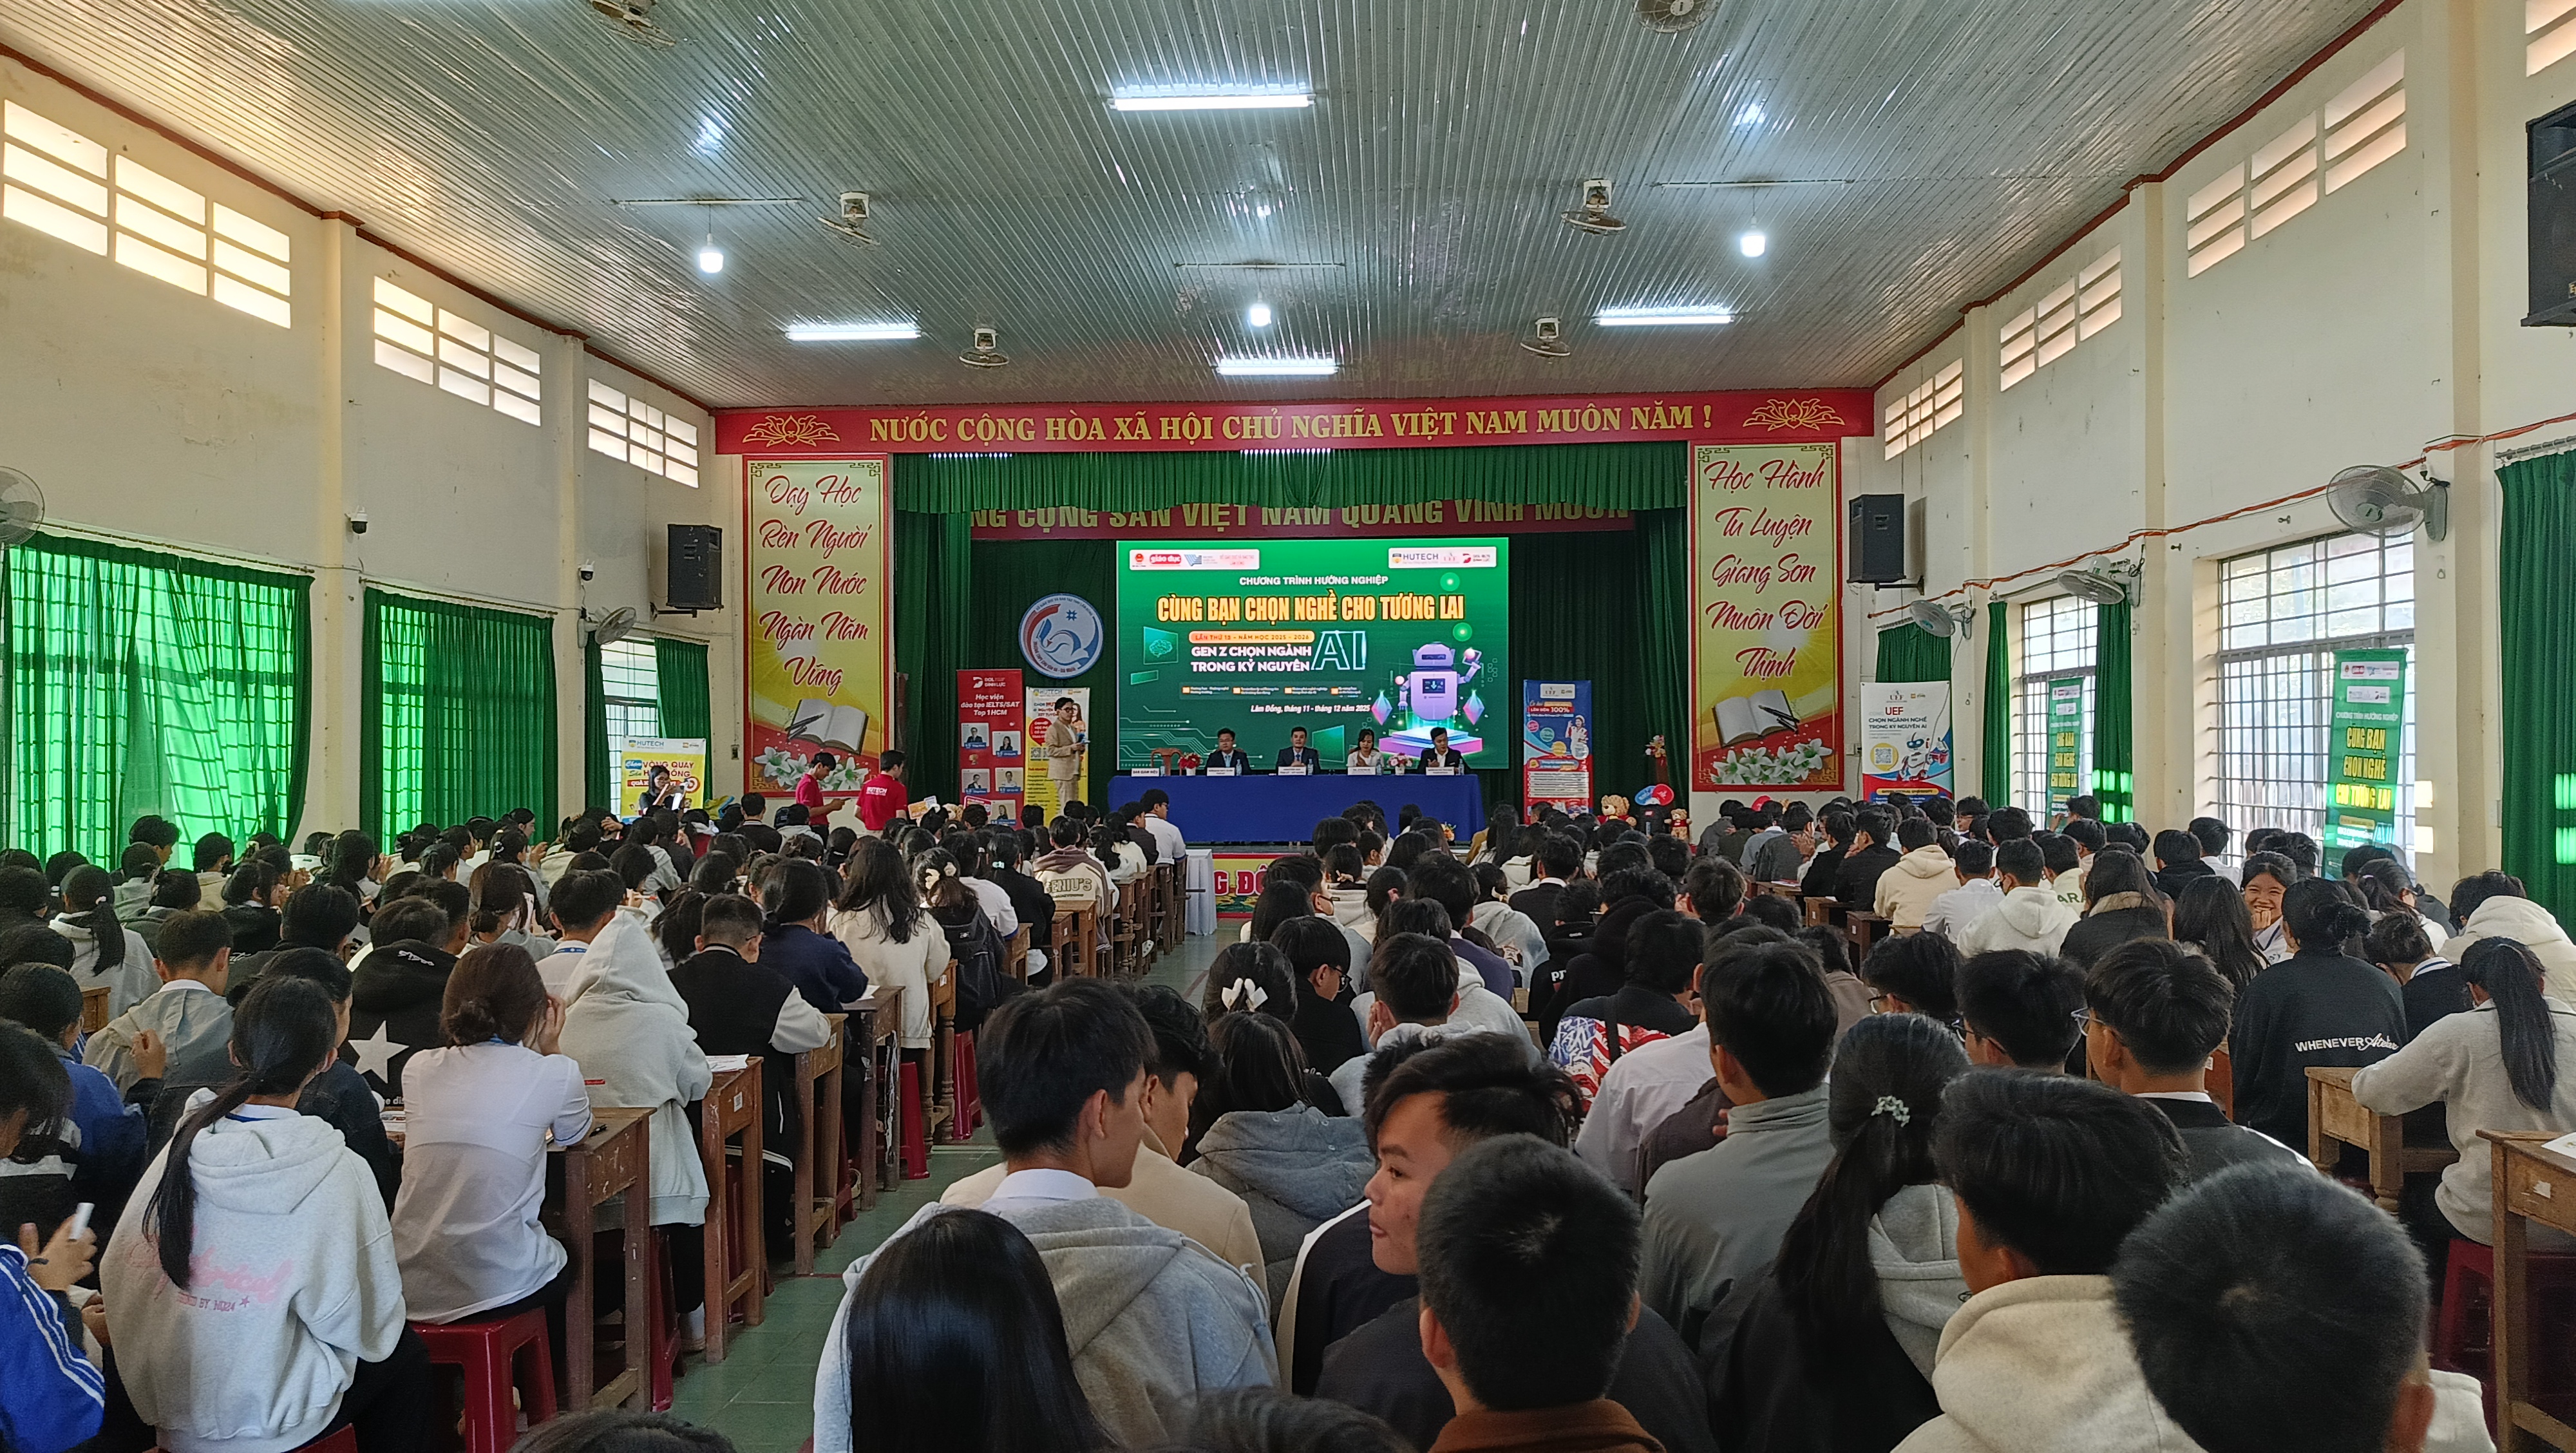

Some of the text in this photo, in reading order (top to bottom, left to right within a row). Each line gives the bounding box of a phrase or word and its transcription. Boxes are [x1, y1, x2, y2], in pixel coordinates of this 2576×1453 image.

[870, 401, 1712, 446] NƯỚC CỘNG HÒA XÃ HỘI CHỦ NGHĨA VIỆT NAM MUÔN NĂM !
[1703, 459, 1826, 494] Học Hành
[764, 475, 862, 515] Dạy Học
[1262, 506, 1329, 526] NAM
[1341, 500, 1443, 528] QUANG
[1455, 499, 1524, 523] VINH
[1715, 507, 1812, 548] Tu Luyện
[759, 519, 873, 559] Rèn Người
[761, 565, 867, 594] Non Nước
[1239, 575, 1388, 585] CHƯƠNG TRÌNH HƯỚNG NGHIỆP
[1712, 553, 1816, 594] Giang Sơn
[1157, 589, 1464, 625] CÙNG BẠN CHỌN NGHỀ CHO TƯƠNG LAI
[1705, 600, 1828, 631] Muôn Đời
[759, 611, 869, 651] Ngàn Năm
[1191, 643, 1312, 658] GEN Z CHỌN NGÀNH
[1191, 661, 1236, 672] TRONG
[1258, 658, 1310, 672] NGUYÊN
[1311, 631, 1367, 670] AI
[1735, 647, 1796, 681] Thịnh
[784, 656, 843, 697] Vững
[1265, 704, 1283, 714] Đồng,
[1283, 705, 1302, 714] tháng
[1315, 705, 1332, 714] tháng
[1885, 707, 1904, 715] UEF
[2367, 728, 2385, 754] BẠN
[2344, 752, 2386, 781] CHỌN NGHỀ
[2378, 788, 2391, 810] LAI
[2295, 1037, 2364, 1052] WHENEVER
[199, 1298, 211, 1309] BY
